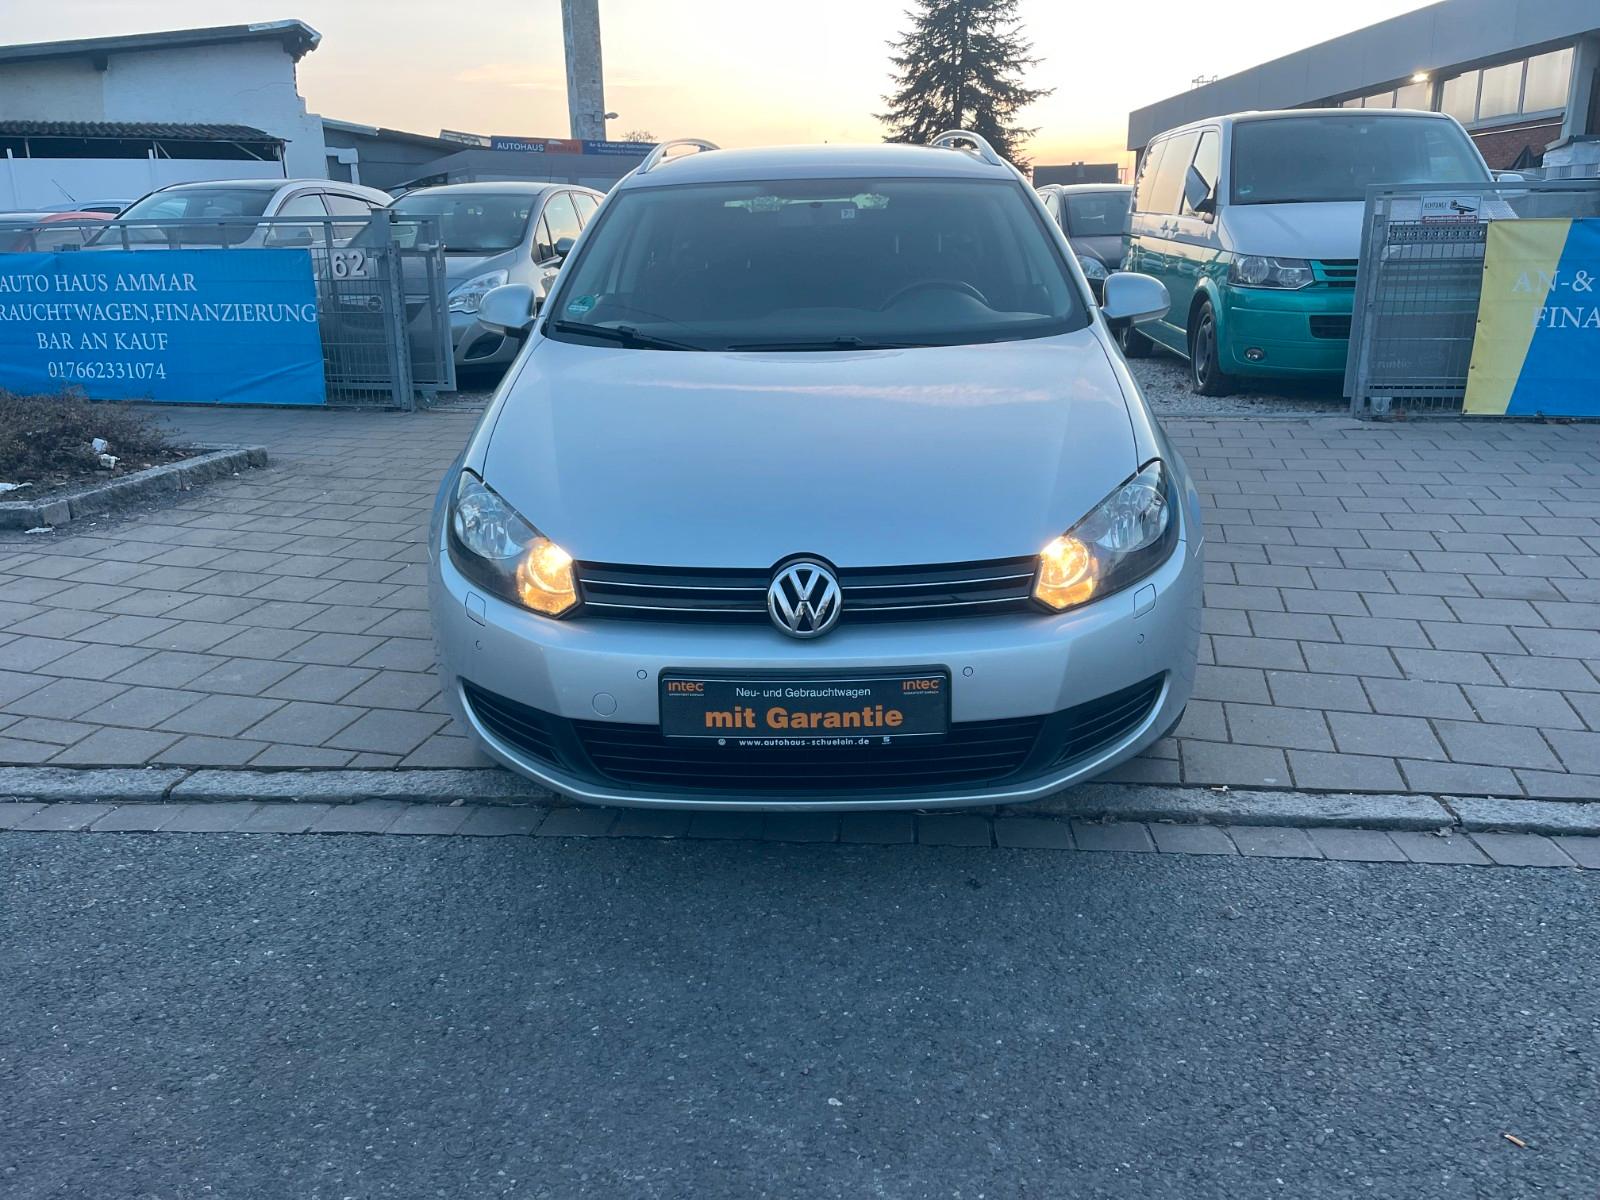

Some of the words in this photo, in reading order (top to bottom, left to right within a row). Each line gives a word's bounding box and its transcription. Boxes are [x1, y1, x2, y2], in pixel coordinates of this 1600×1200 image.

[497, 142, 544, 152] AUTOHAUS
[330, 250, 367, 279] 62
[0, 274, 49, 292] AUTO
[55, 274, 108, 292] HAUS
[115, 273, 198, 292] AMMAR
[1533, 306, 1600, 328] FINA
[37, 333, 75, 350] BAR
[80, 332, 108, 350] AN
[114, 332, 168, 351] KAUF
[48, 361, 167, 380] 017662331074
[735, 687, 761, 697] Neu-
[763, 688, 782, 697] und
[785, 686, 871, 699] Gebrauchtwagen
[705, 706, 756, 728] mit
[766, 704, 904, 729] Garantie
